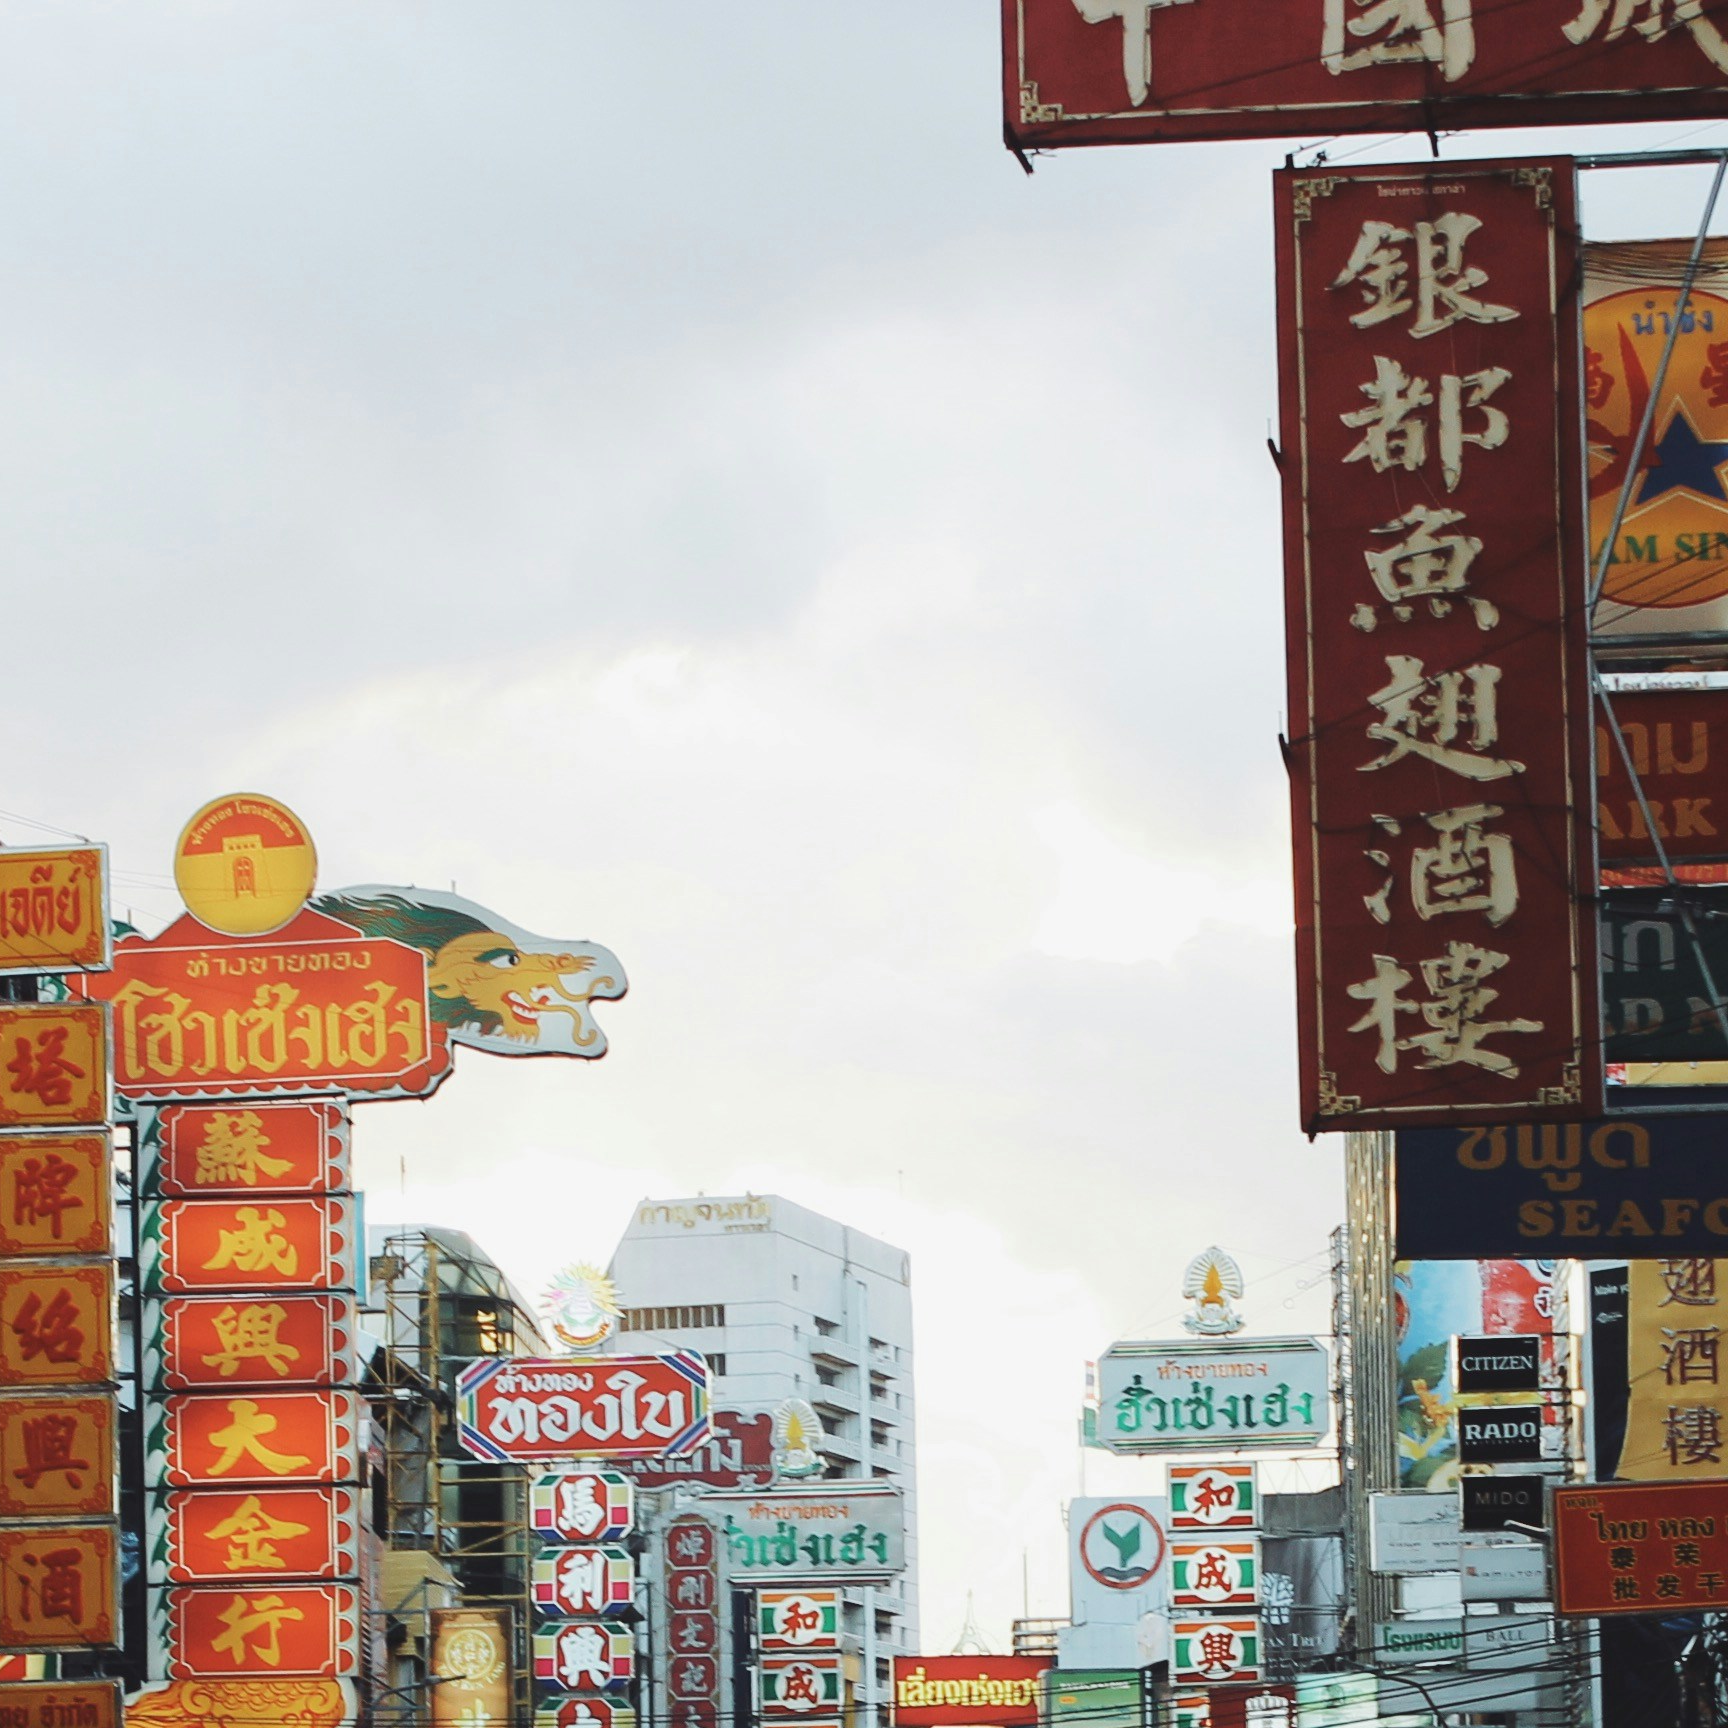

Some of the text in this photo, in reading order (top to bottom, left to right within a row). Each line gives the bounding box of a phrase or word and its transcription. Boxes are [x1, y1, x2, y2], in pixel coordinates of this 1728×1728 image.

[1590, 534, 1661, 565] AM
[1324, 210, 1544, 1082] 銀都魚翅酒樓
[6, 1026, 88, 1626] 塔牌紹興酒
[1462, 1355, 1534, 1372] CITIZEN
[495, 1365, 594, 1394] ห้างทอง
[487, 1369, 686, 1444] ทองใบ
[1465, 1421, 1537, 1441] RADO
[1475, 1491, 1530, 1505] MIDO
[1589, 1511, 1649, 1543] ไทย
[1486, 1629, 1527, 1642] BALL
